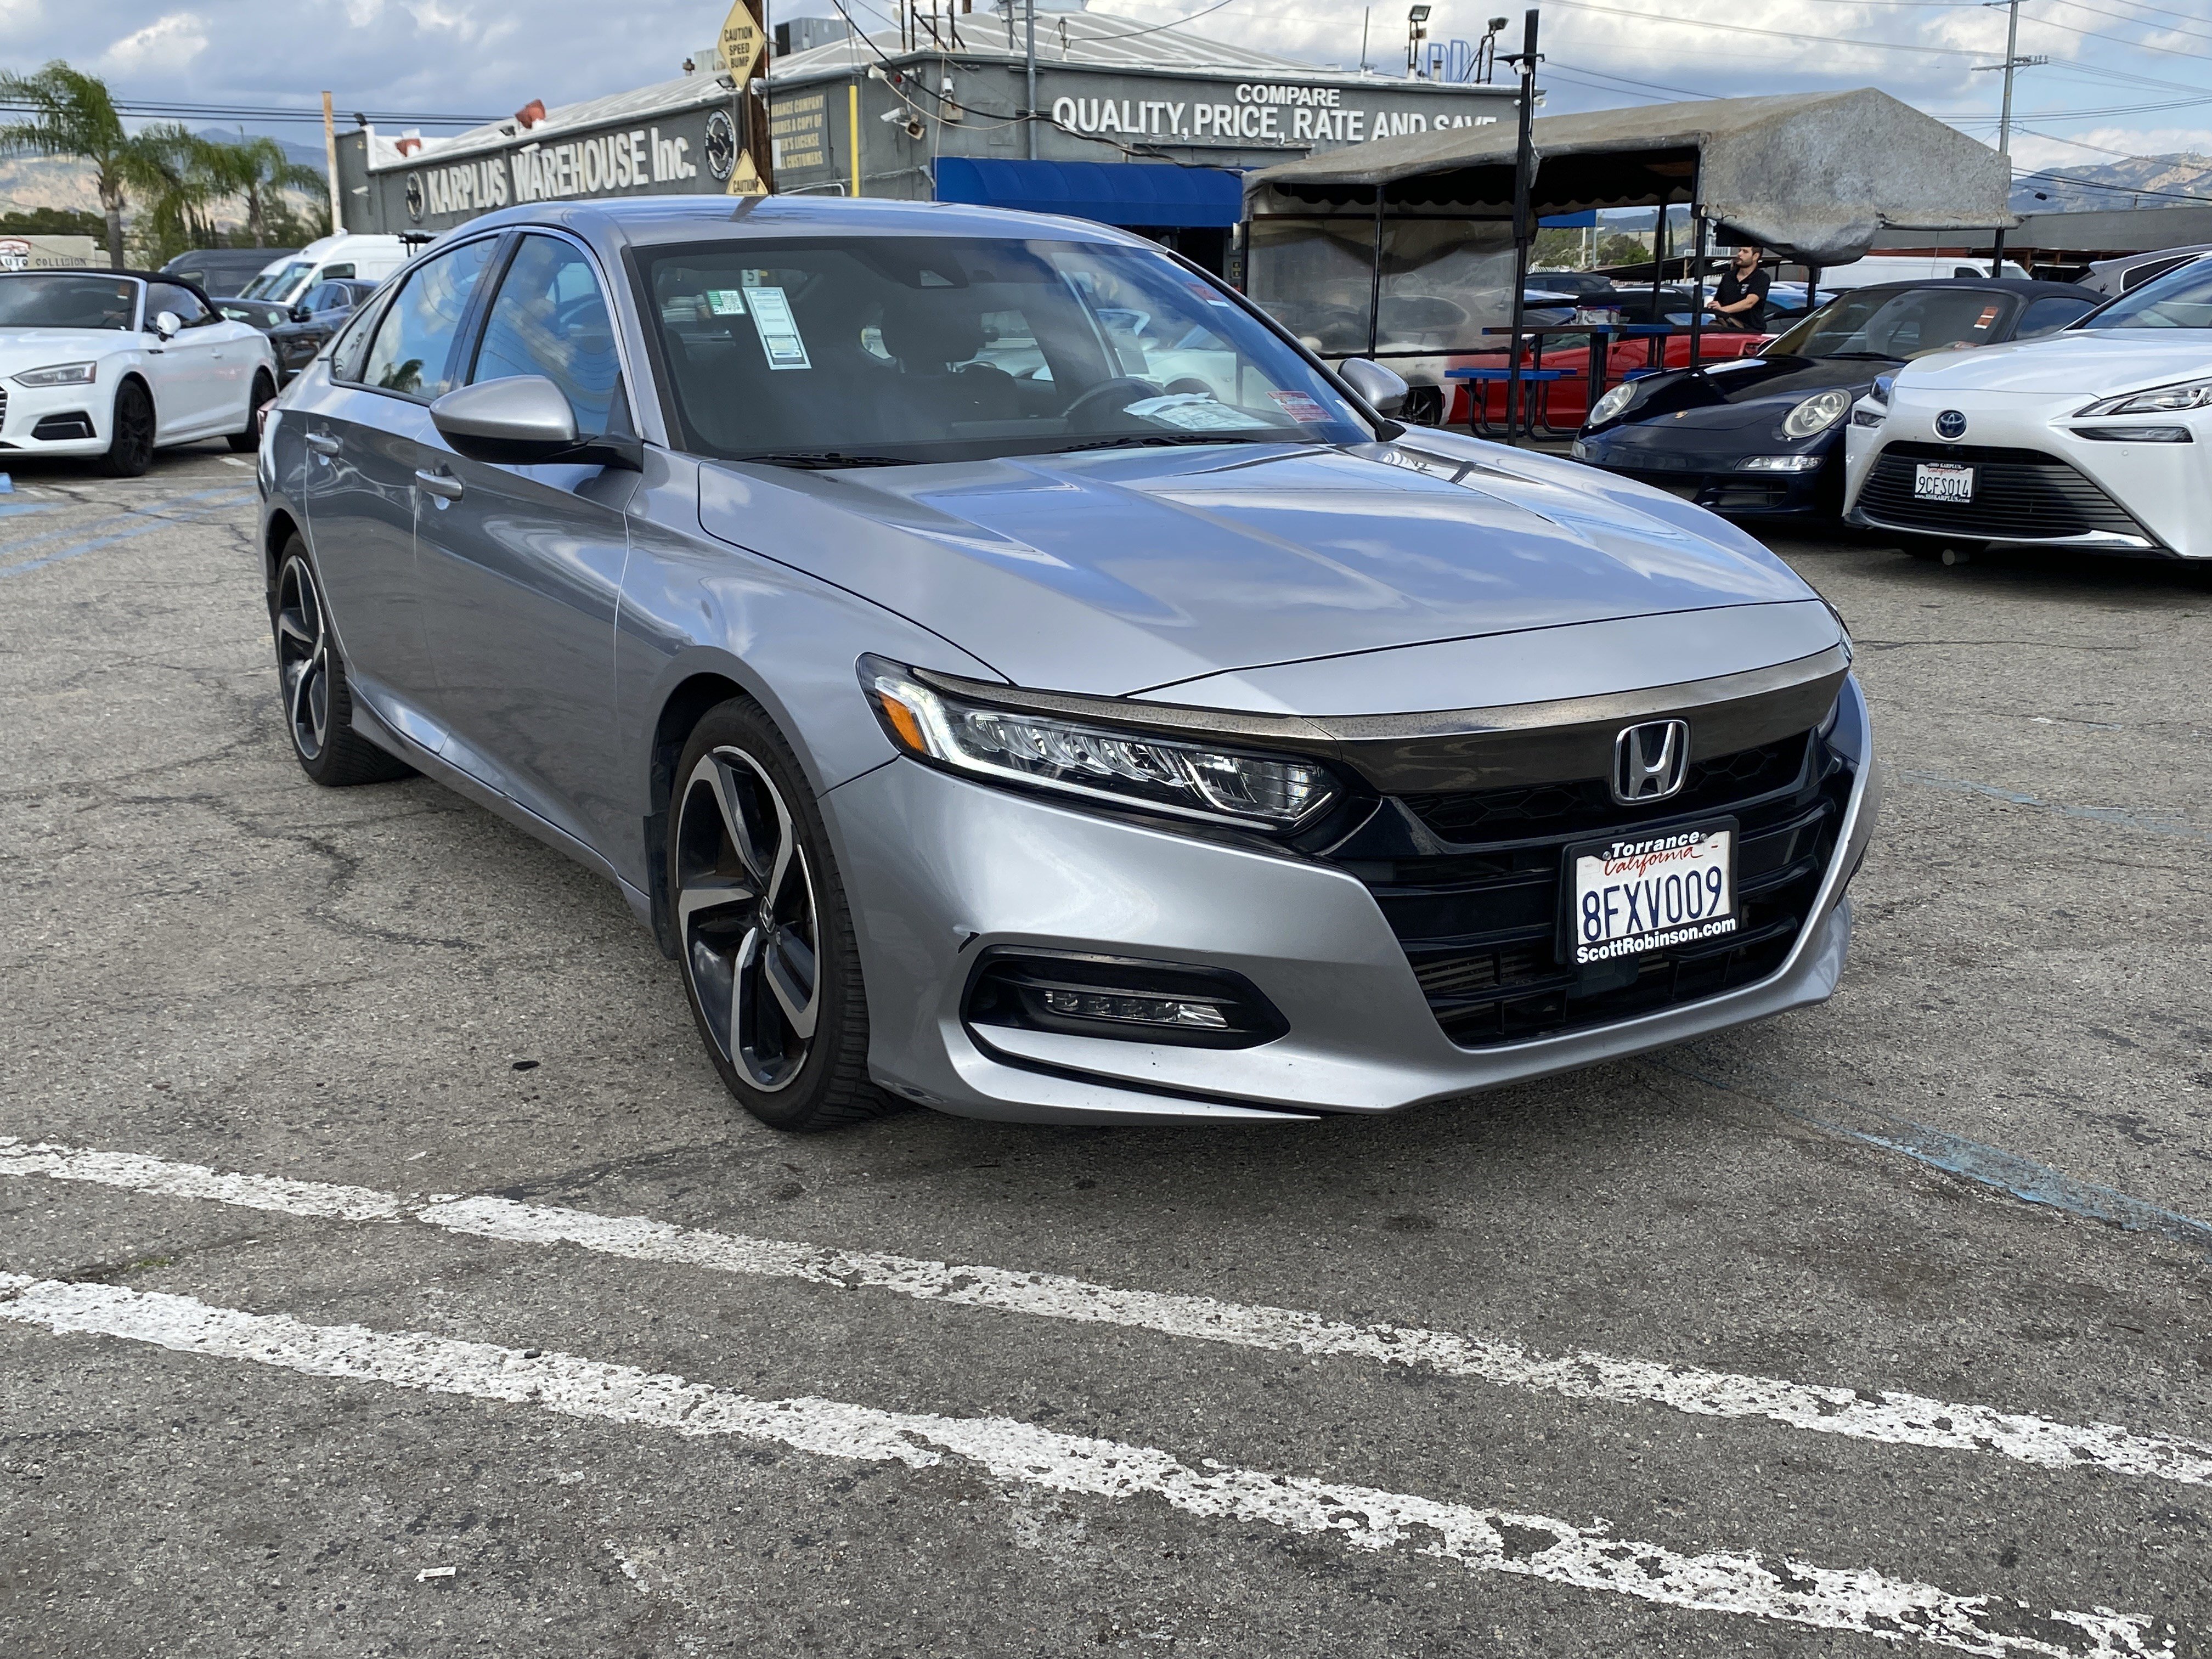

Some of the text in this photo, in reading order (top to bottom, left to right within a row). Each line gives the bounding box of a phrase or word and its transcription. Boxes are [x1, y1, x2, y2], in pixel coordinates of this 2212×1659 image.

[724, 26, 753, 42] CAUTION
[729, 43, 749, 55] SPEED
[731, 56, 749, 68] BUMP
[794, 94, 824, 113] COMPANY
[1234, 84, 1340, 108] COMPARE
[797, 115, 813, 131] COPY
[1052, 97, 1189, 140] QUALITY,
[1194, 104, 1285, 145] PRICE,
[1293, 108, 1364, 141] RATE
[1370, 112, 1427, 142] AND
[794, 132, 820, 149] LICENSE
[786, 151, 823, 168] CUSTOMERS
[427, 158, 509, 215] KARPLUS
[511, 130, 648, 202] WAREHOUSE
[651, 127, 696, 182] Inc.
[36, 258, 87, 267] COLLISION
[1918, 476, 1969, 496] 9CFS014
[1611, 831, 1700, 857] Torrance
[1605, 846, 1704, 878] California
[1582, 866, 1722, 942] 8FXV009
[1577, 917, 1736, 964] ScottRobinson.com
